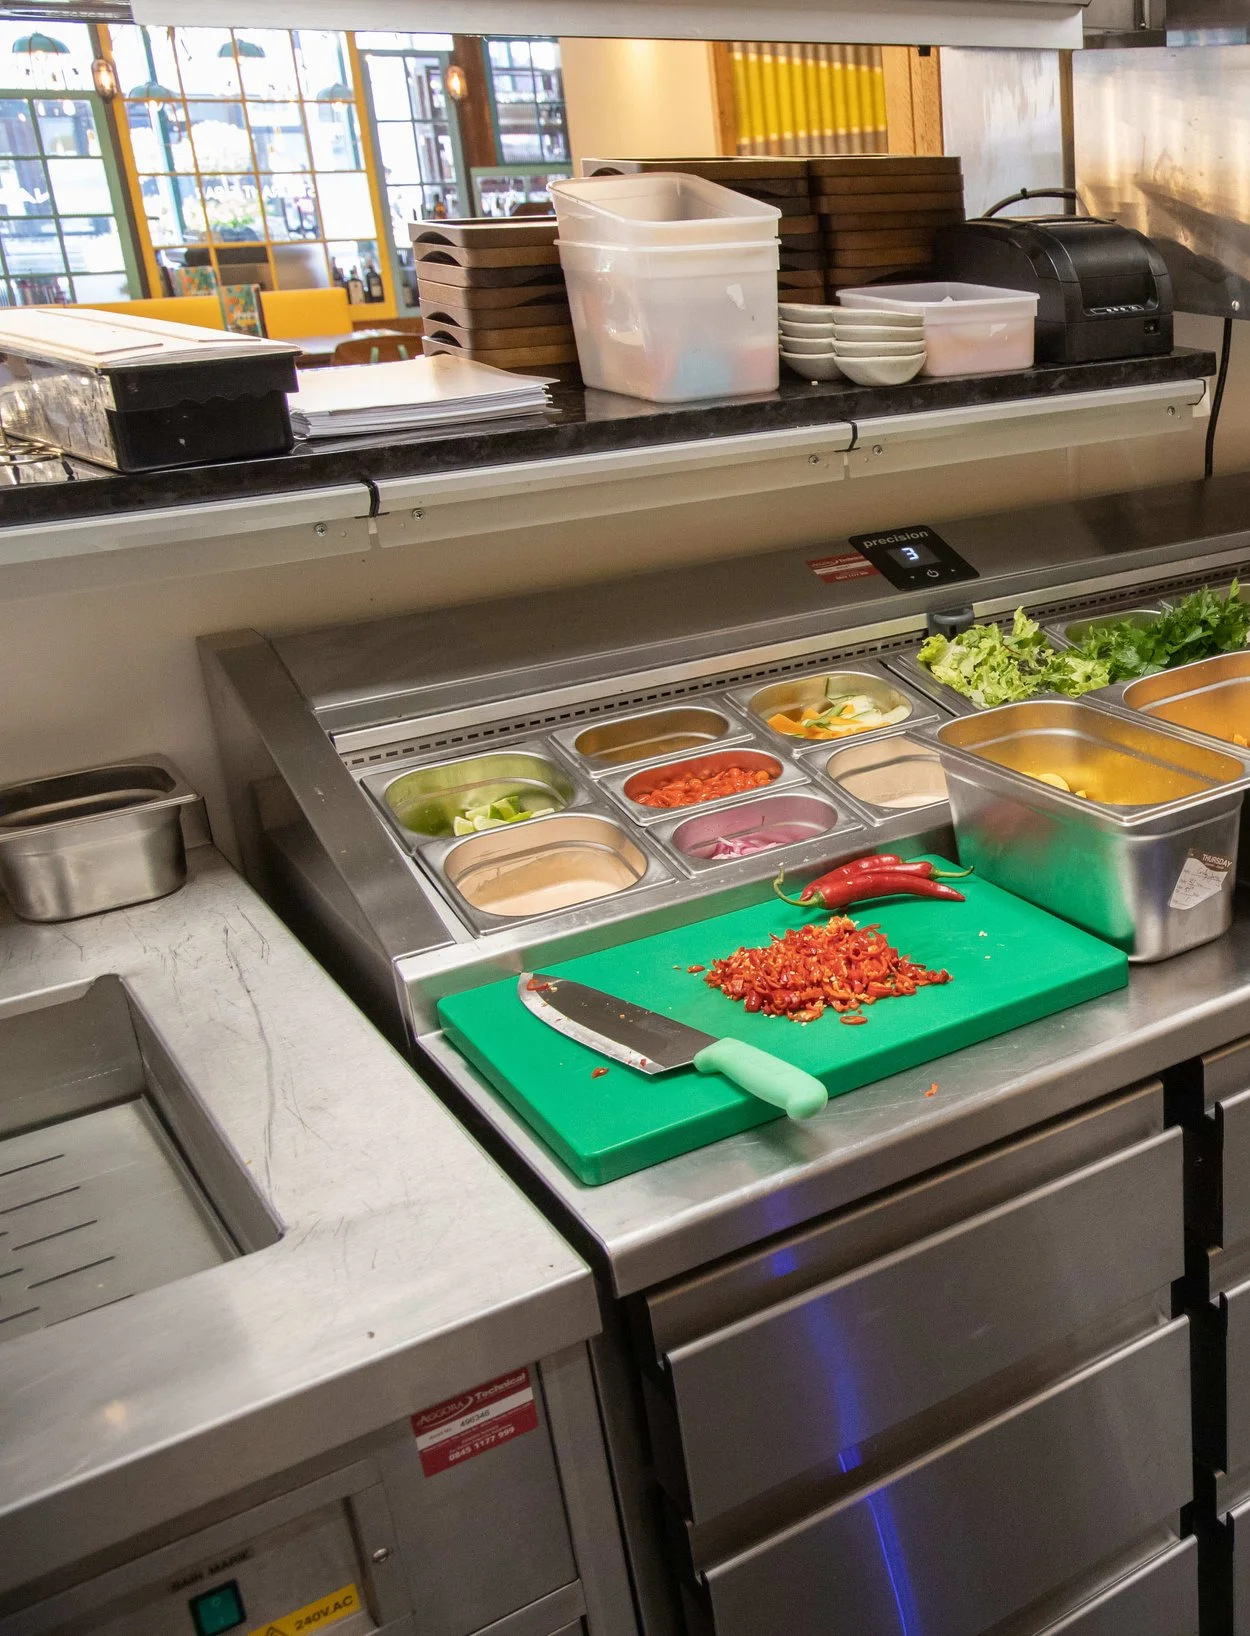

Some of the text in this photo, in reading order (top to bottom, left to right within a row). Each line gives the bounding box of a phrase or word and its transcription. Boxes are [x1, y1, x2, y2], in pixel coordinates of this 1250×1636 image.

[863, 530, 929, 549] precision
[900, 547, 919, 561] 3
[1202, 853, 1233, 868] THURSDAY
[474, 1373, 526, 1401] Technical
[473, 1436, 496, 1450] 1177
